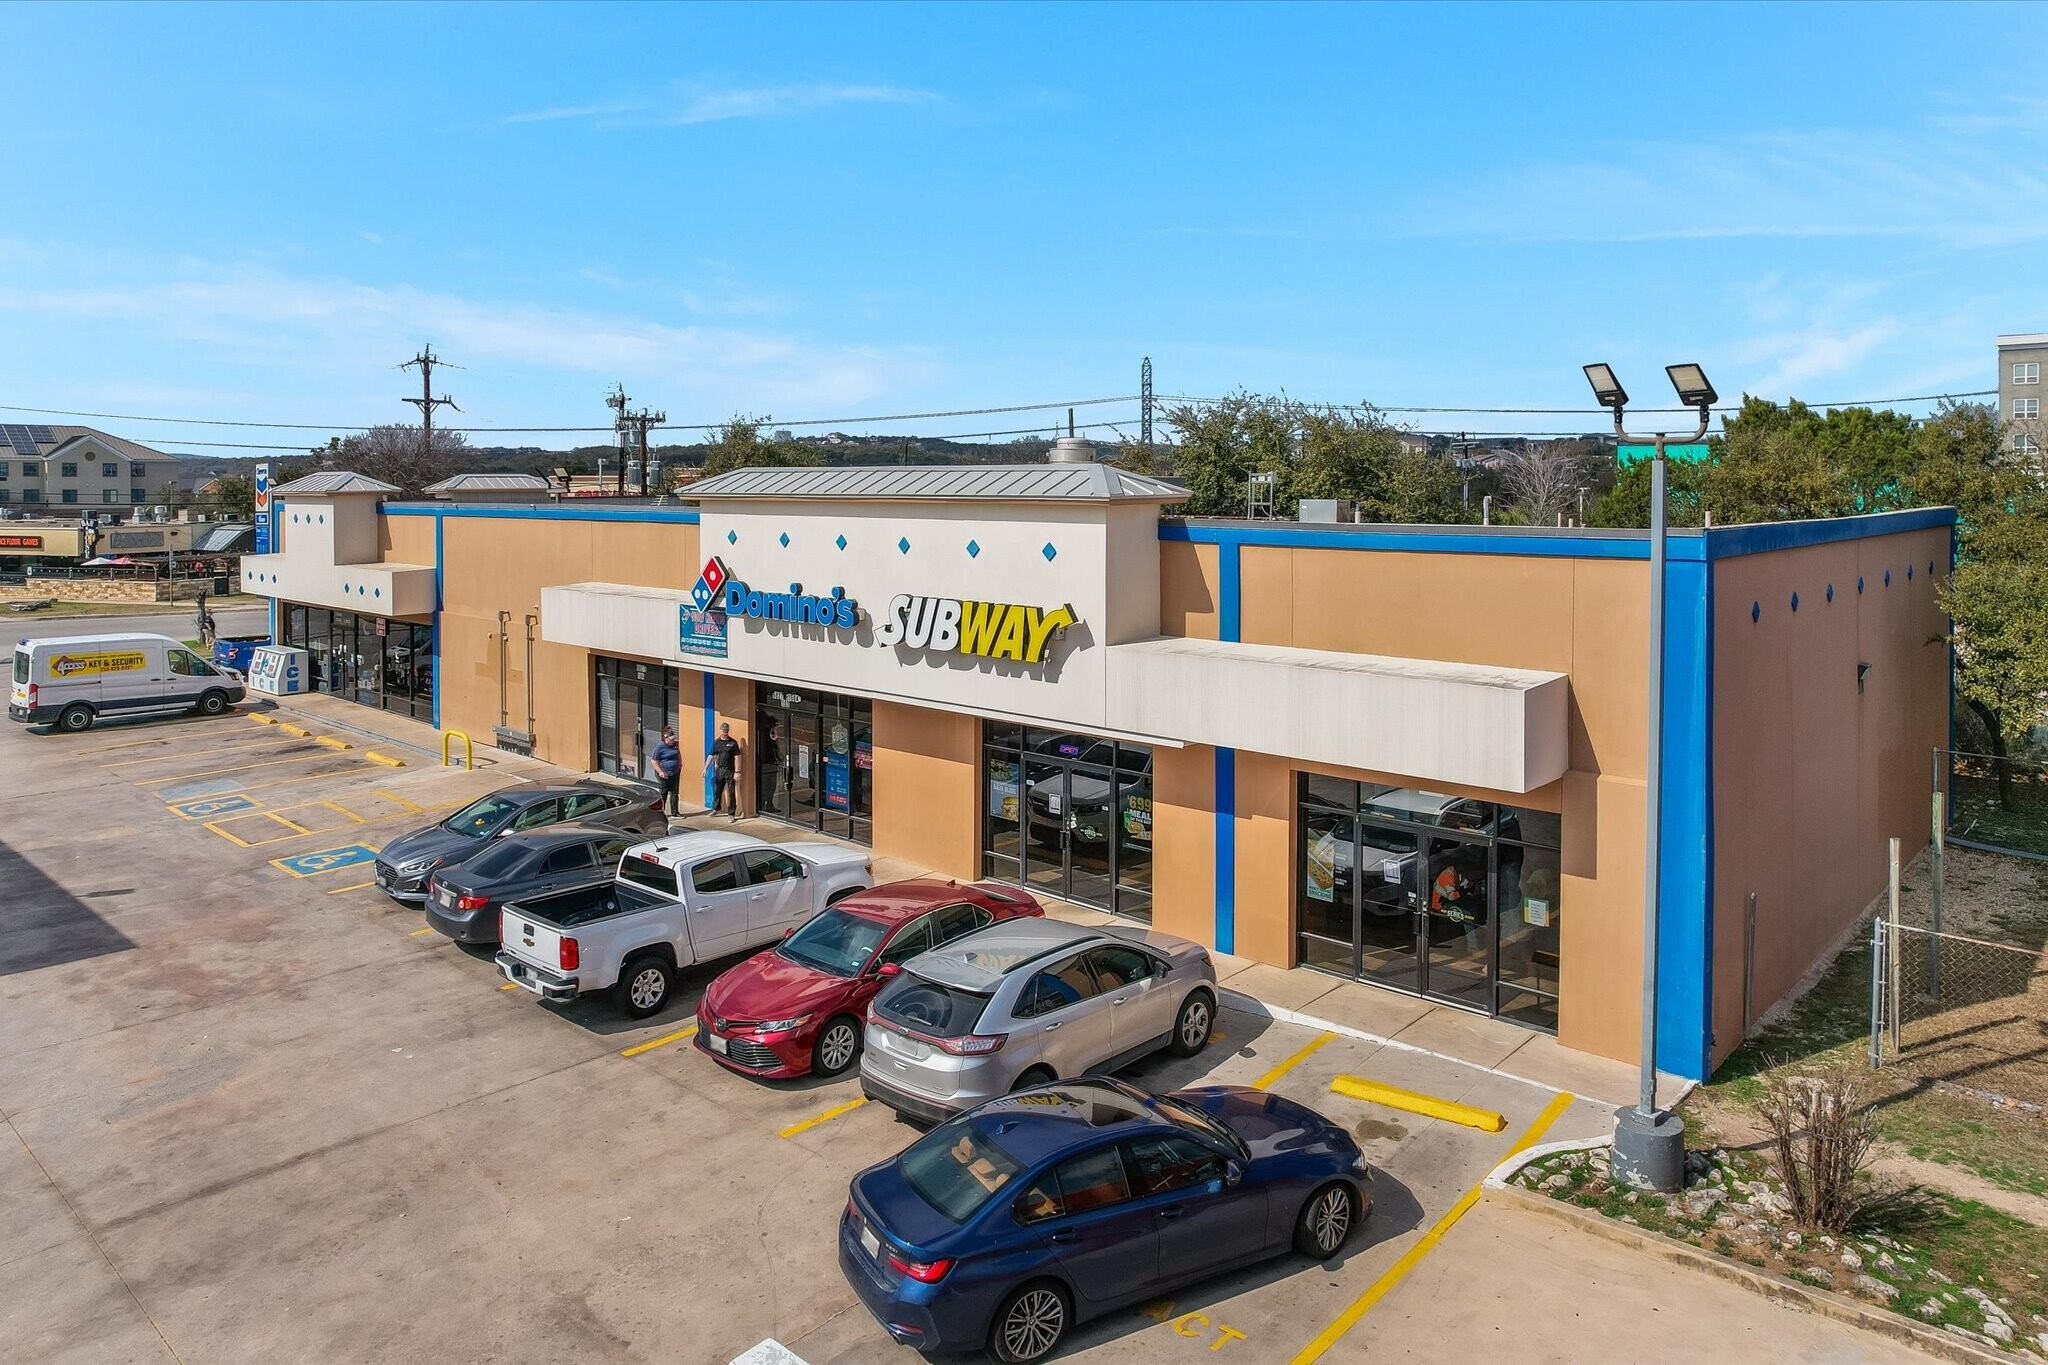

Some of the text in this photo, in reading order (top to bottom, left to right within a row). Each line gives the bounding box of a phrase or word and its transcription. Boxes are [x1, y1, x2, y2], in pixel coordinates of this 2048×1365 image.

[22, 537, 39, 546] GAMES
[725, 580, 859, 629] Domino's
[874, 593, 1079, 663] SUBWAY
[89, 660, 101, 668] KEY
[104, 659, 109, 667] &
[111, 656, 144, 667] SECURITY
[286, 653, 300, 692] ICE
[252, 677, 275, 692] ICE
[1130, 809, 1151, 821] MEAL
